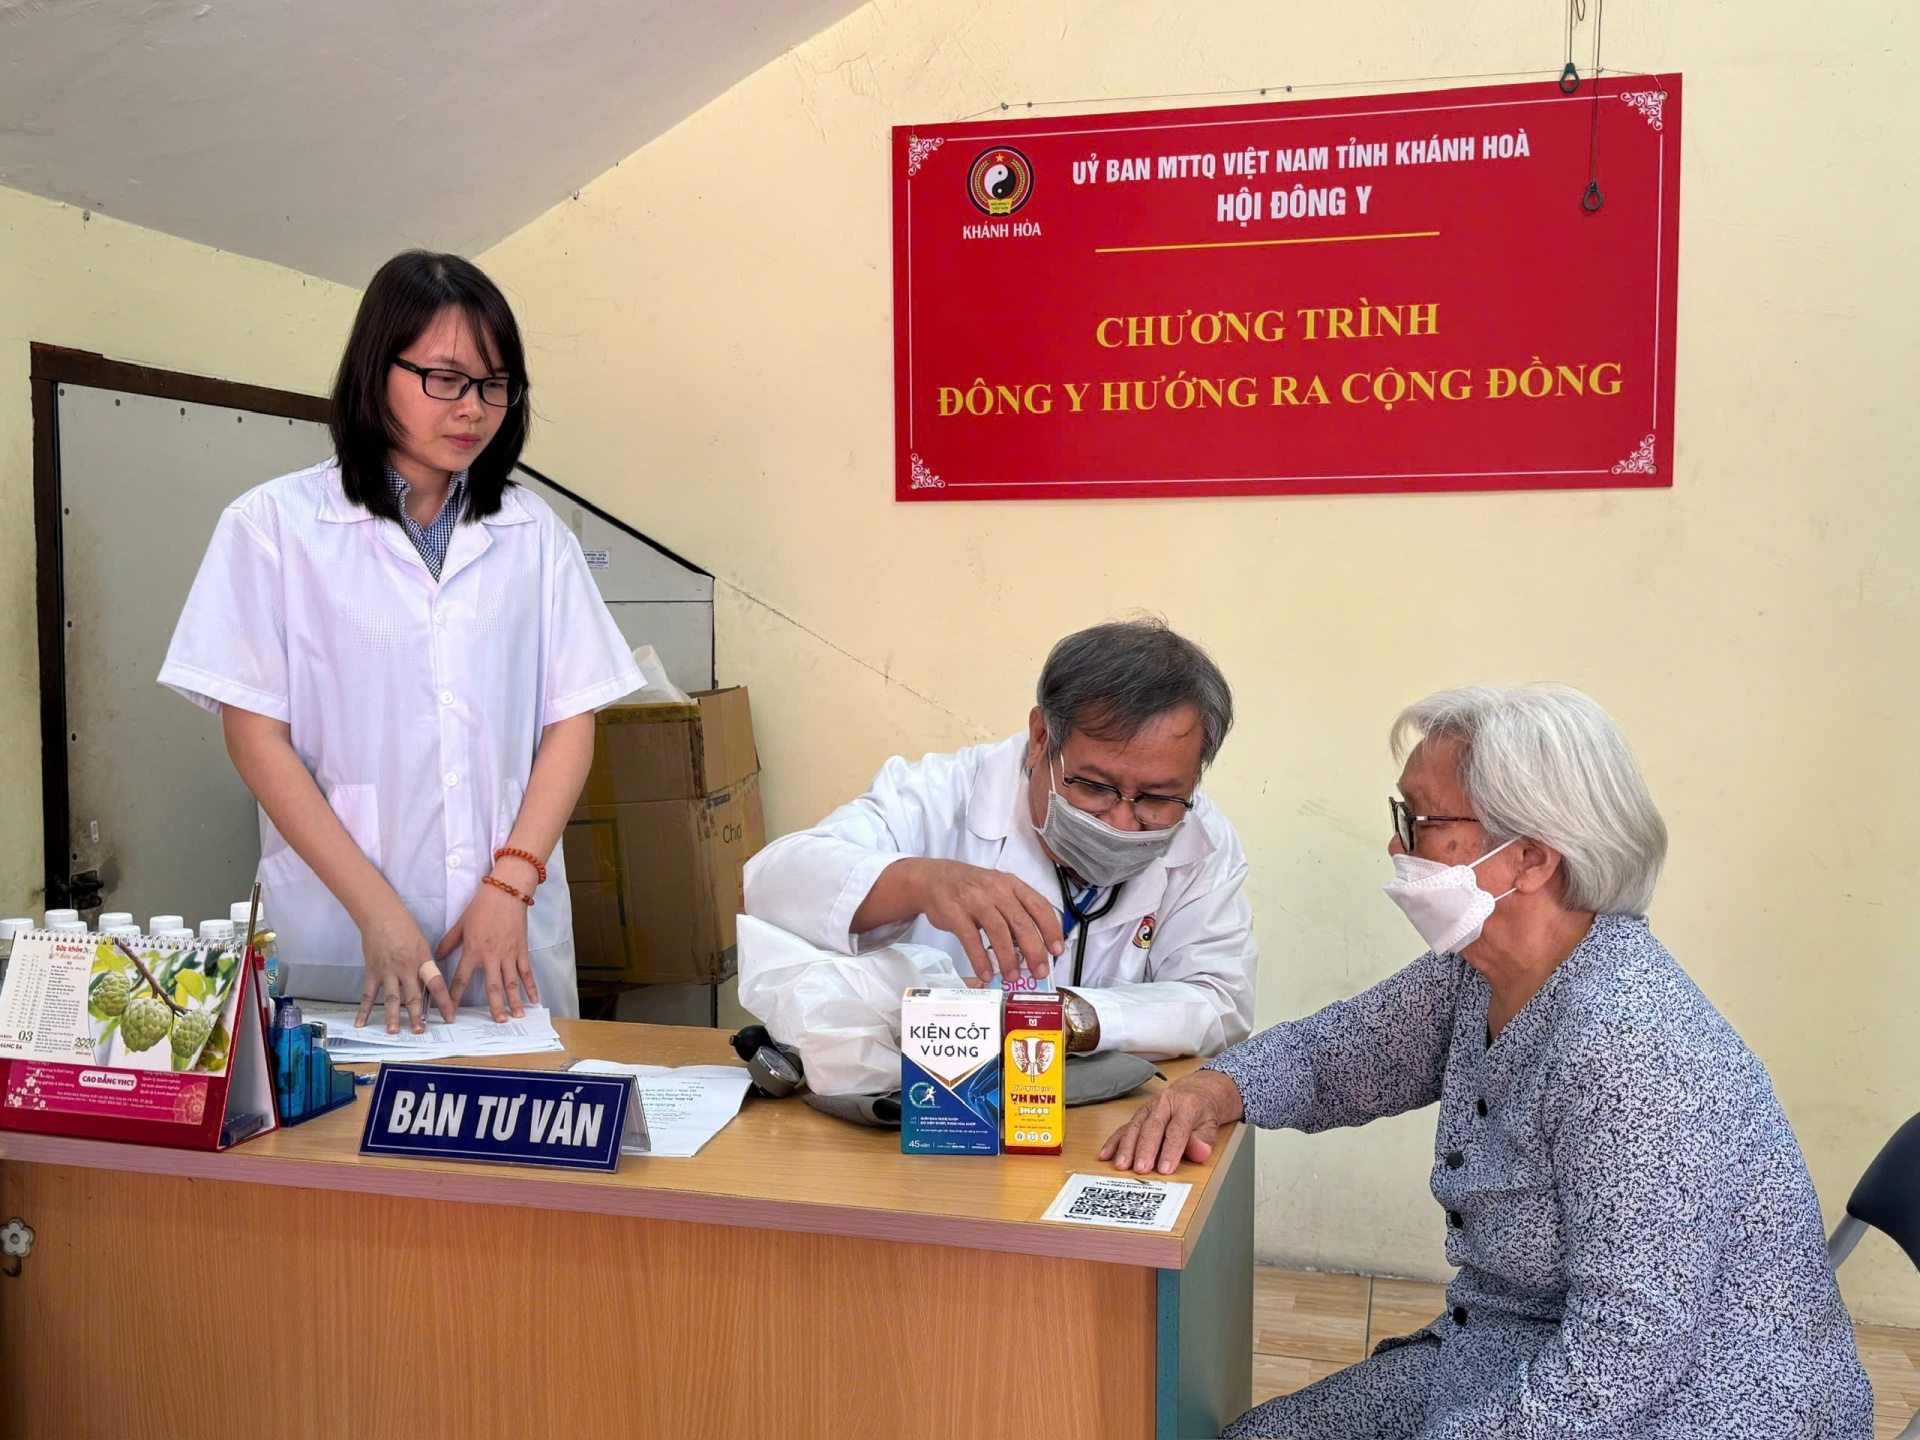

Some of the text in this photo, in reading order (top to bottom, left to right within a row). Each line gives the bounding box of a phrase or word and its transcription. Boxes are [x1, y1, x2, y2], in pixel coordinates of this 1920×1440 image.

[1072, 128, 1530, 185] UỶ BAN MTTQ VIỆT NAM TỈNH KHÁNH HOÀ
[1216, 184, 1373, 227] HỘI ĐÔNG Y
[962, 218, 1042, 239] KHÁNH HÒA
[1096, 297, 1440, 348] CHƯƠNG TRÌNH
[937, 356, 1624, 417] ĐÔNG Y HƯỚNG RA CỘNG ĐỒNG
[18, 1029, 34, 1042] 03
[910, 1022, 990, 1042] KIỆN CỐT
[74, 1037, 97, 1049] 2026
[920, 1045, 979, 1057] VƯƠNG
[82, 1076, 96, 1084] CAO
[1029, 1094, 1056, 1104] NAM
[387, 1083, 467, 1137] BÀN
[475, 1093, 527, 1141] TƯ
[529, 1086, 604, 1147] VẤN
[908, 1140, 920, 1148] 45
